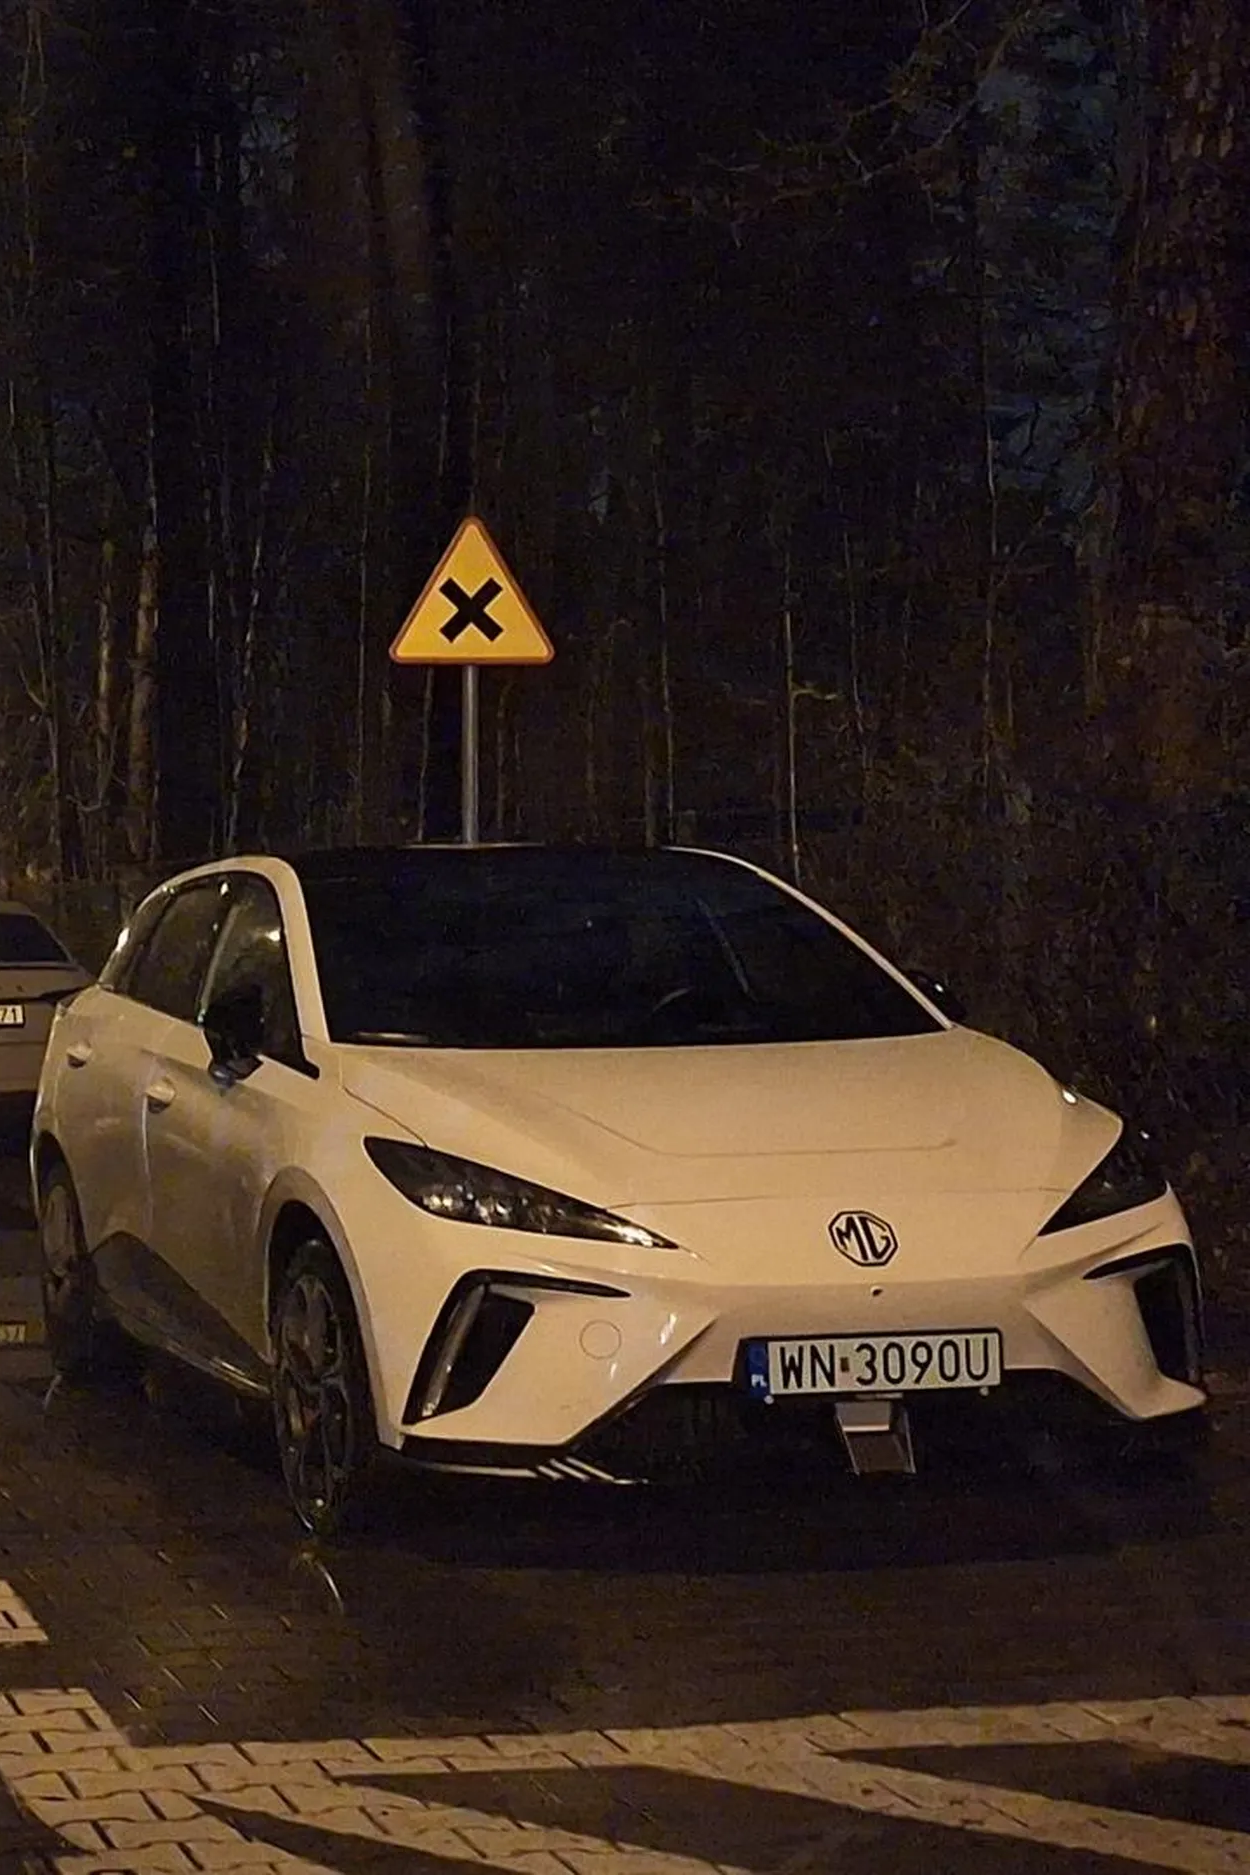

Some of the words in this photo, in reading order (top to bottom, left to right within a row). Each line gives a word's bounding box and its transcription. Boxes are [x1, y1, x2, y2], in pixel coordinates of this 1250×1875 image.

[834, 1214, 892, 1263] MG
[751, 1374, 767, 1388] PL
[779, 1345, 836, 1389] WN
[855, 1338, 989, 1385] 3090U
